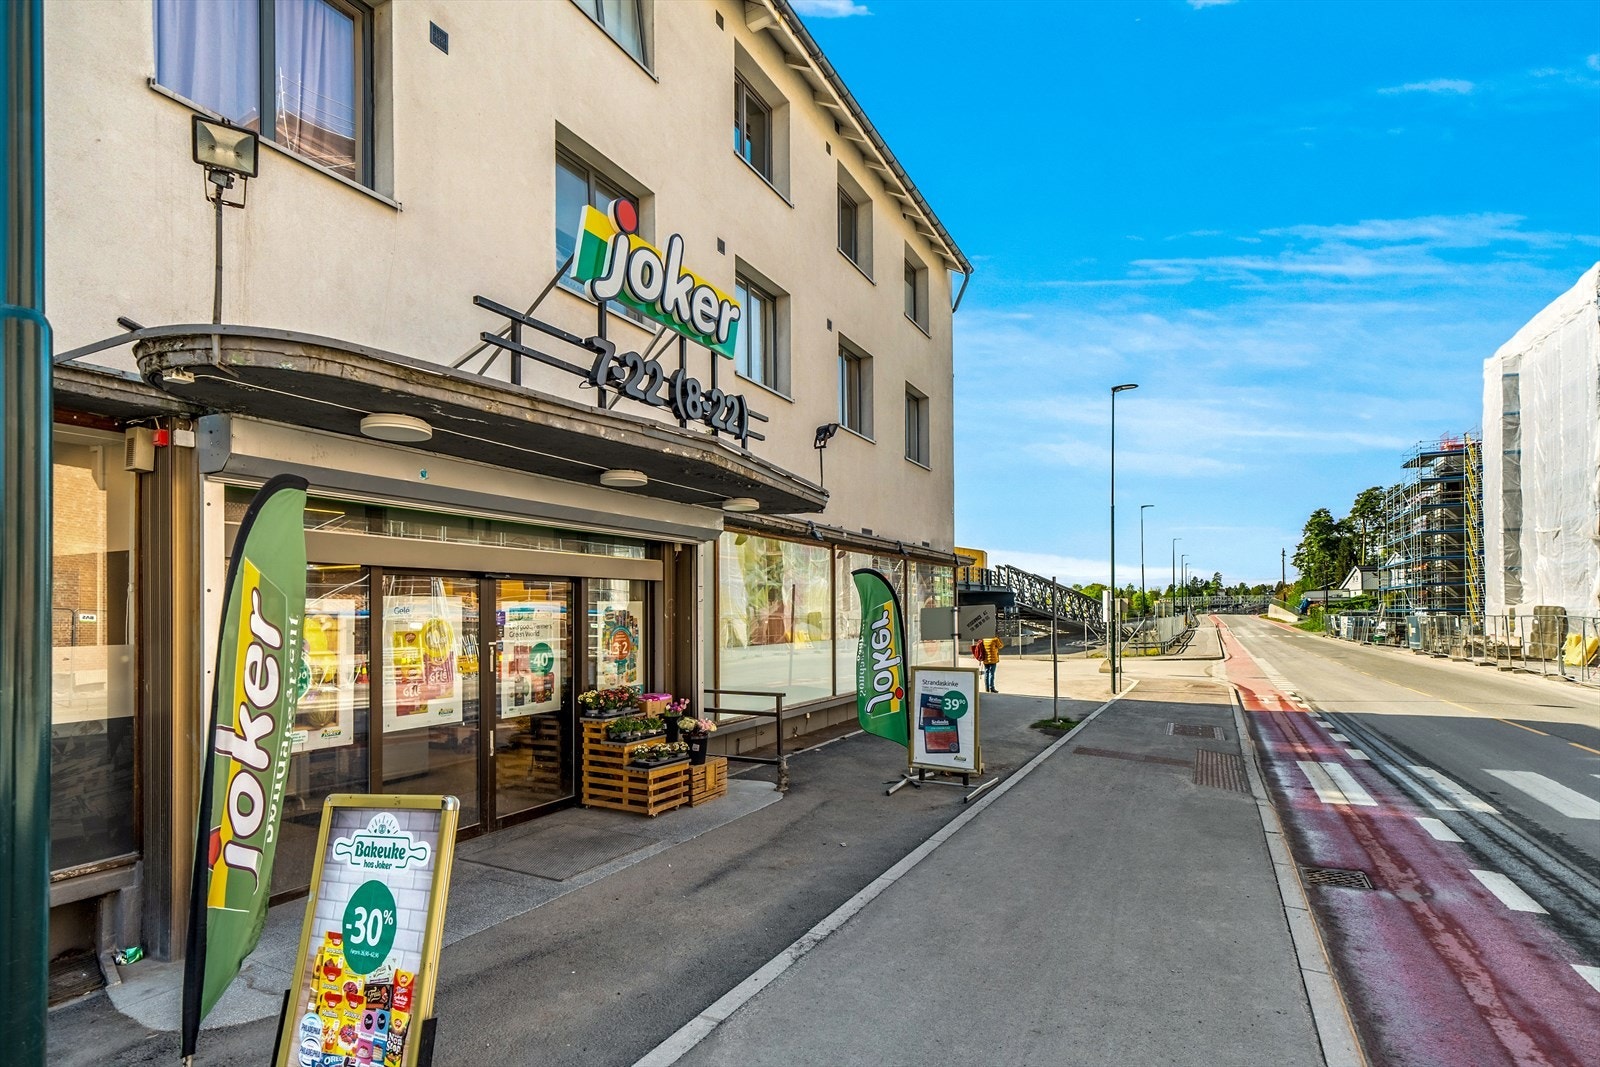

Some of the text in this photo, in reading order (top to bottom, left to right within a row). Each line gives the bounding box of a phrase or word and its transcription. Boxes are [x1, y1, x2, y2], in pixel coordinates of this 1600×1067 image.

[922, 679, 959, 688] Strandaskinke
[355, 840, 406, 860] Bakeuke
[363, 859, 392, 869] hos Joker
